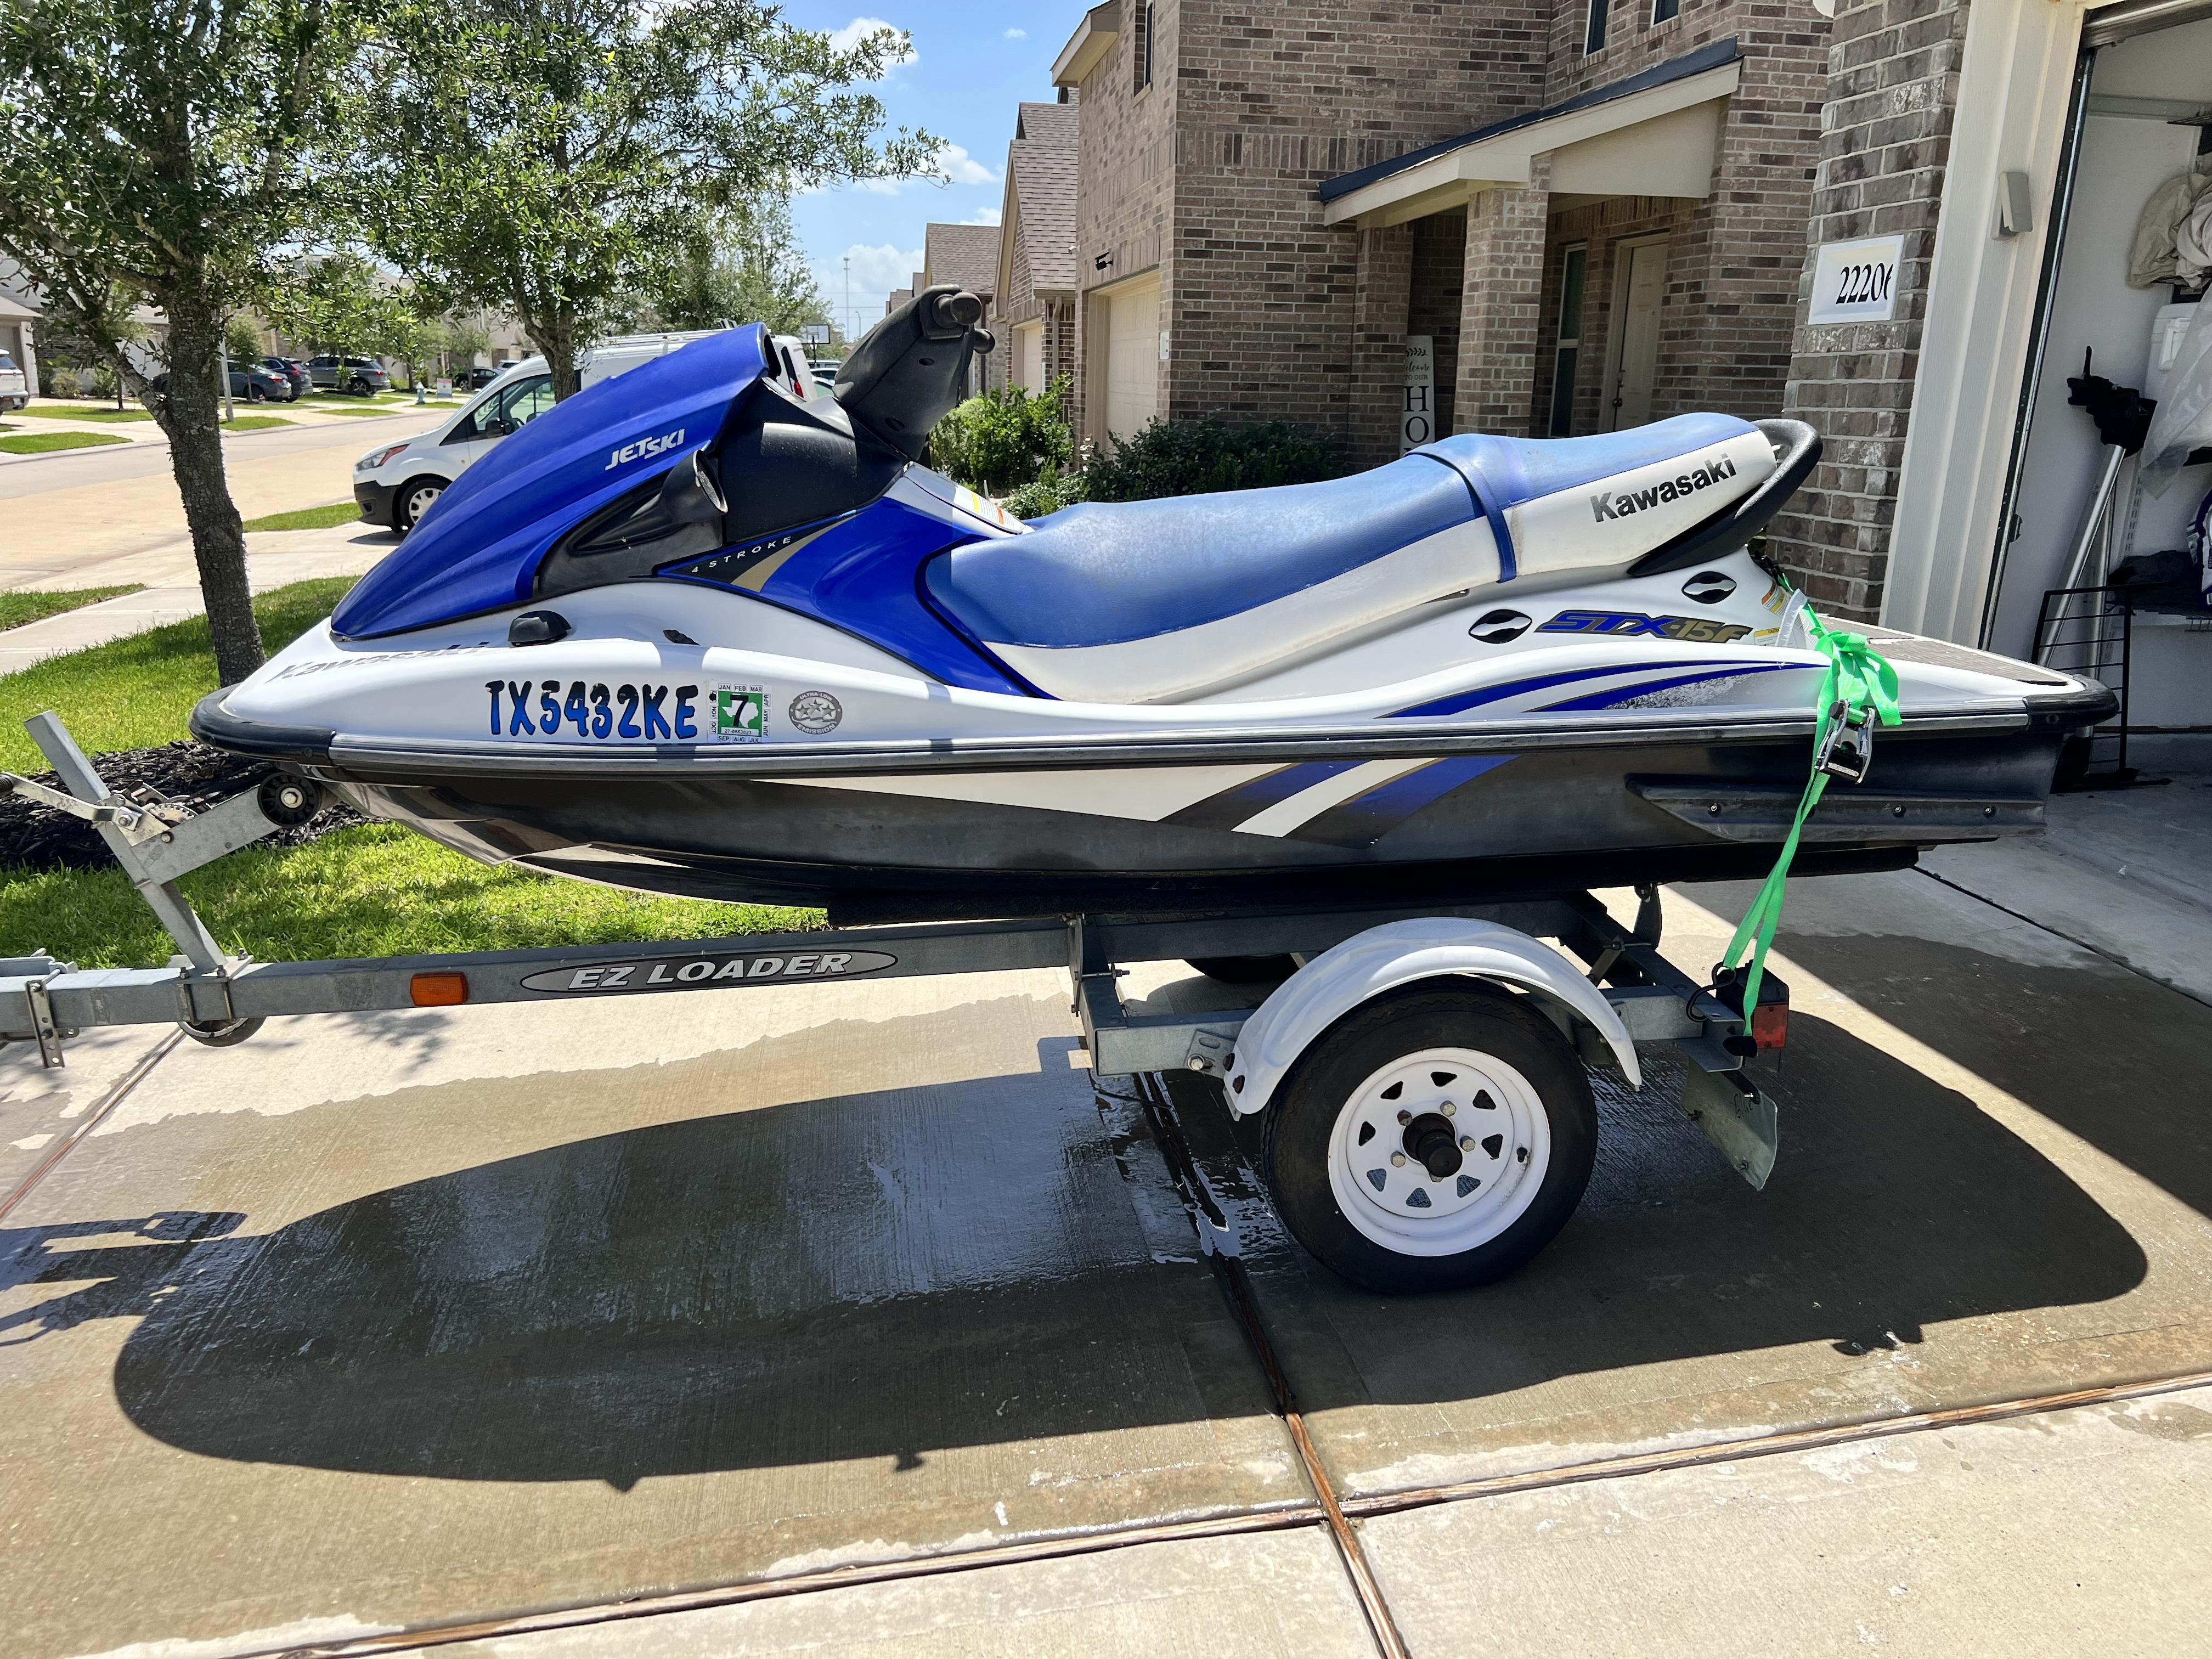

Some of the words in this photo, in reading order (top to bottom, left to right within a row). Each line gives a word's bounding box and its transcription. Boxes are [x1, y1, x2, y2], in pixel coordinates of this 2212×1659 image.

[1406, 361, 1431, 372] elcome
[1403, 386, 1430, 453] HO
[1590, 453, 1736, 522] Kawasaki
[709, 537, 791, 568] STROKE
[1541, 612, 1752, 643] STX-15F
[264, 641, 489, 684] Kawasaki
[485, 680, 698, 740] TX5432KE
[730, 695, 749, 727] 7
[799, 692, 833, 701] ULTRA-LOW
[797, 723, 836, 734] EMISSION
[568, 966, 637, 990] EZ
[646, 953, 853, 985] LOADER
